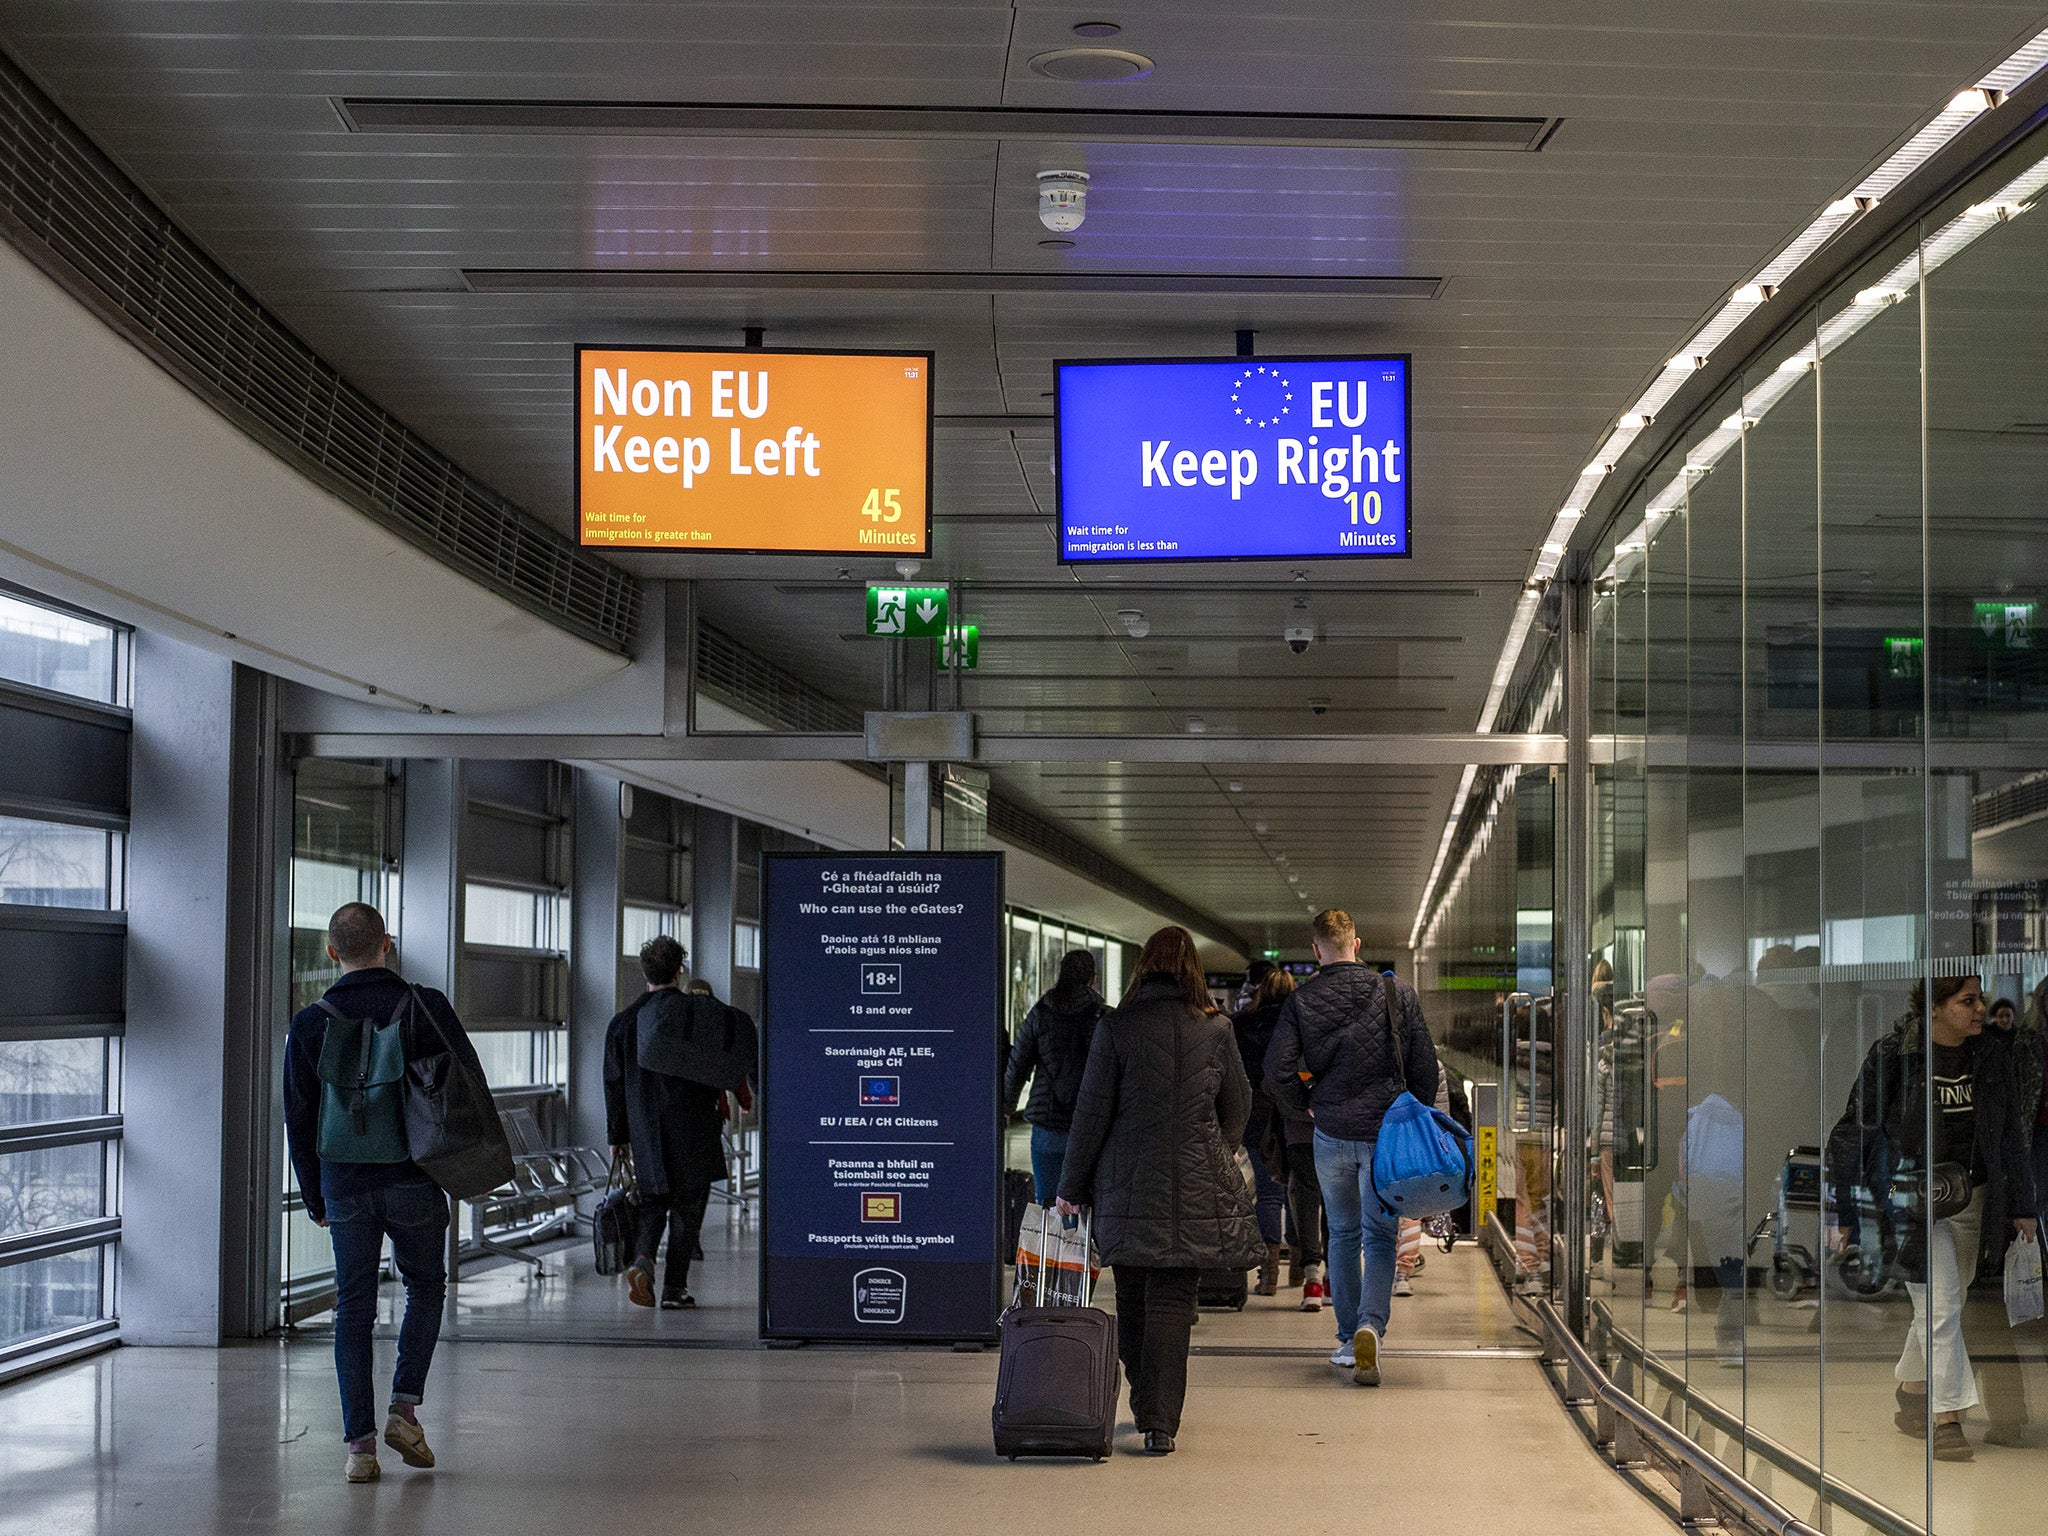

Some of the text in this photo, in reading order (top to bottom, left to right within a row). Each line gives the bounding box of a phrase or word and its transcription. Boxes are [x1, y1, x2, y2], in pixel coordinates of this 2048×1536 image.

[592, 367, 769, 419] Non EU
[1311, 380, 1367, 429] EU
[592, 424, 821, 489] Keep Left
[1141, 434, 1401, 500] Keep Right
[861, 488, 902, 523] 45
[1343, 491, 1381, 525] 10
[585, 511, 647, 523] Wait time for
[585, 528, 712, 542] immigration is greater than
[1067, 524, 1129, 536] Wait time for
[859, 528, 917, 546] Minutes
[1339, 531, 1396, 548] Minutes
[1068, 539, 1178, 553] immigration is less than
[821, 871, 942, 882] Cé a fhéadfaidh na
[823, 883, 940, 894] r-Gheataí a úsúid?
[799, 903, 964, 915] Who can use the eGates?
[821, 935, 942, 944] Daoine atá 18 mbliana
[859, 947, 886, 957] agus
[889, 946, 912, 955] níos
[914, 946, 938, 955] sine
[865, 972, 897, 986] 18+
[849, 1006, 913, 1015] 18 and over
[825, 1047, 935, 1058] Saoránaigh AE, LEE,
[856, 1058, 903, 1068] agus CH
[820, 1117, 939, 1127] EU / EEA / CH Citizens
[828, 1159, 934, 1169] Pasanna a bhfuil an
[833, 1170, 929, 1180] tsiombail seo acu
[808, 1234, 955, 1247] Passports with this symbol
